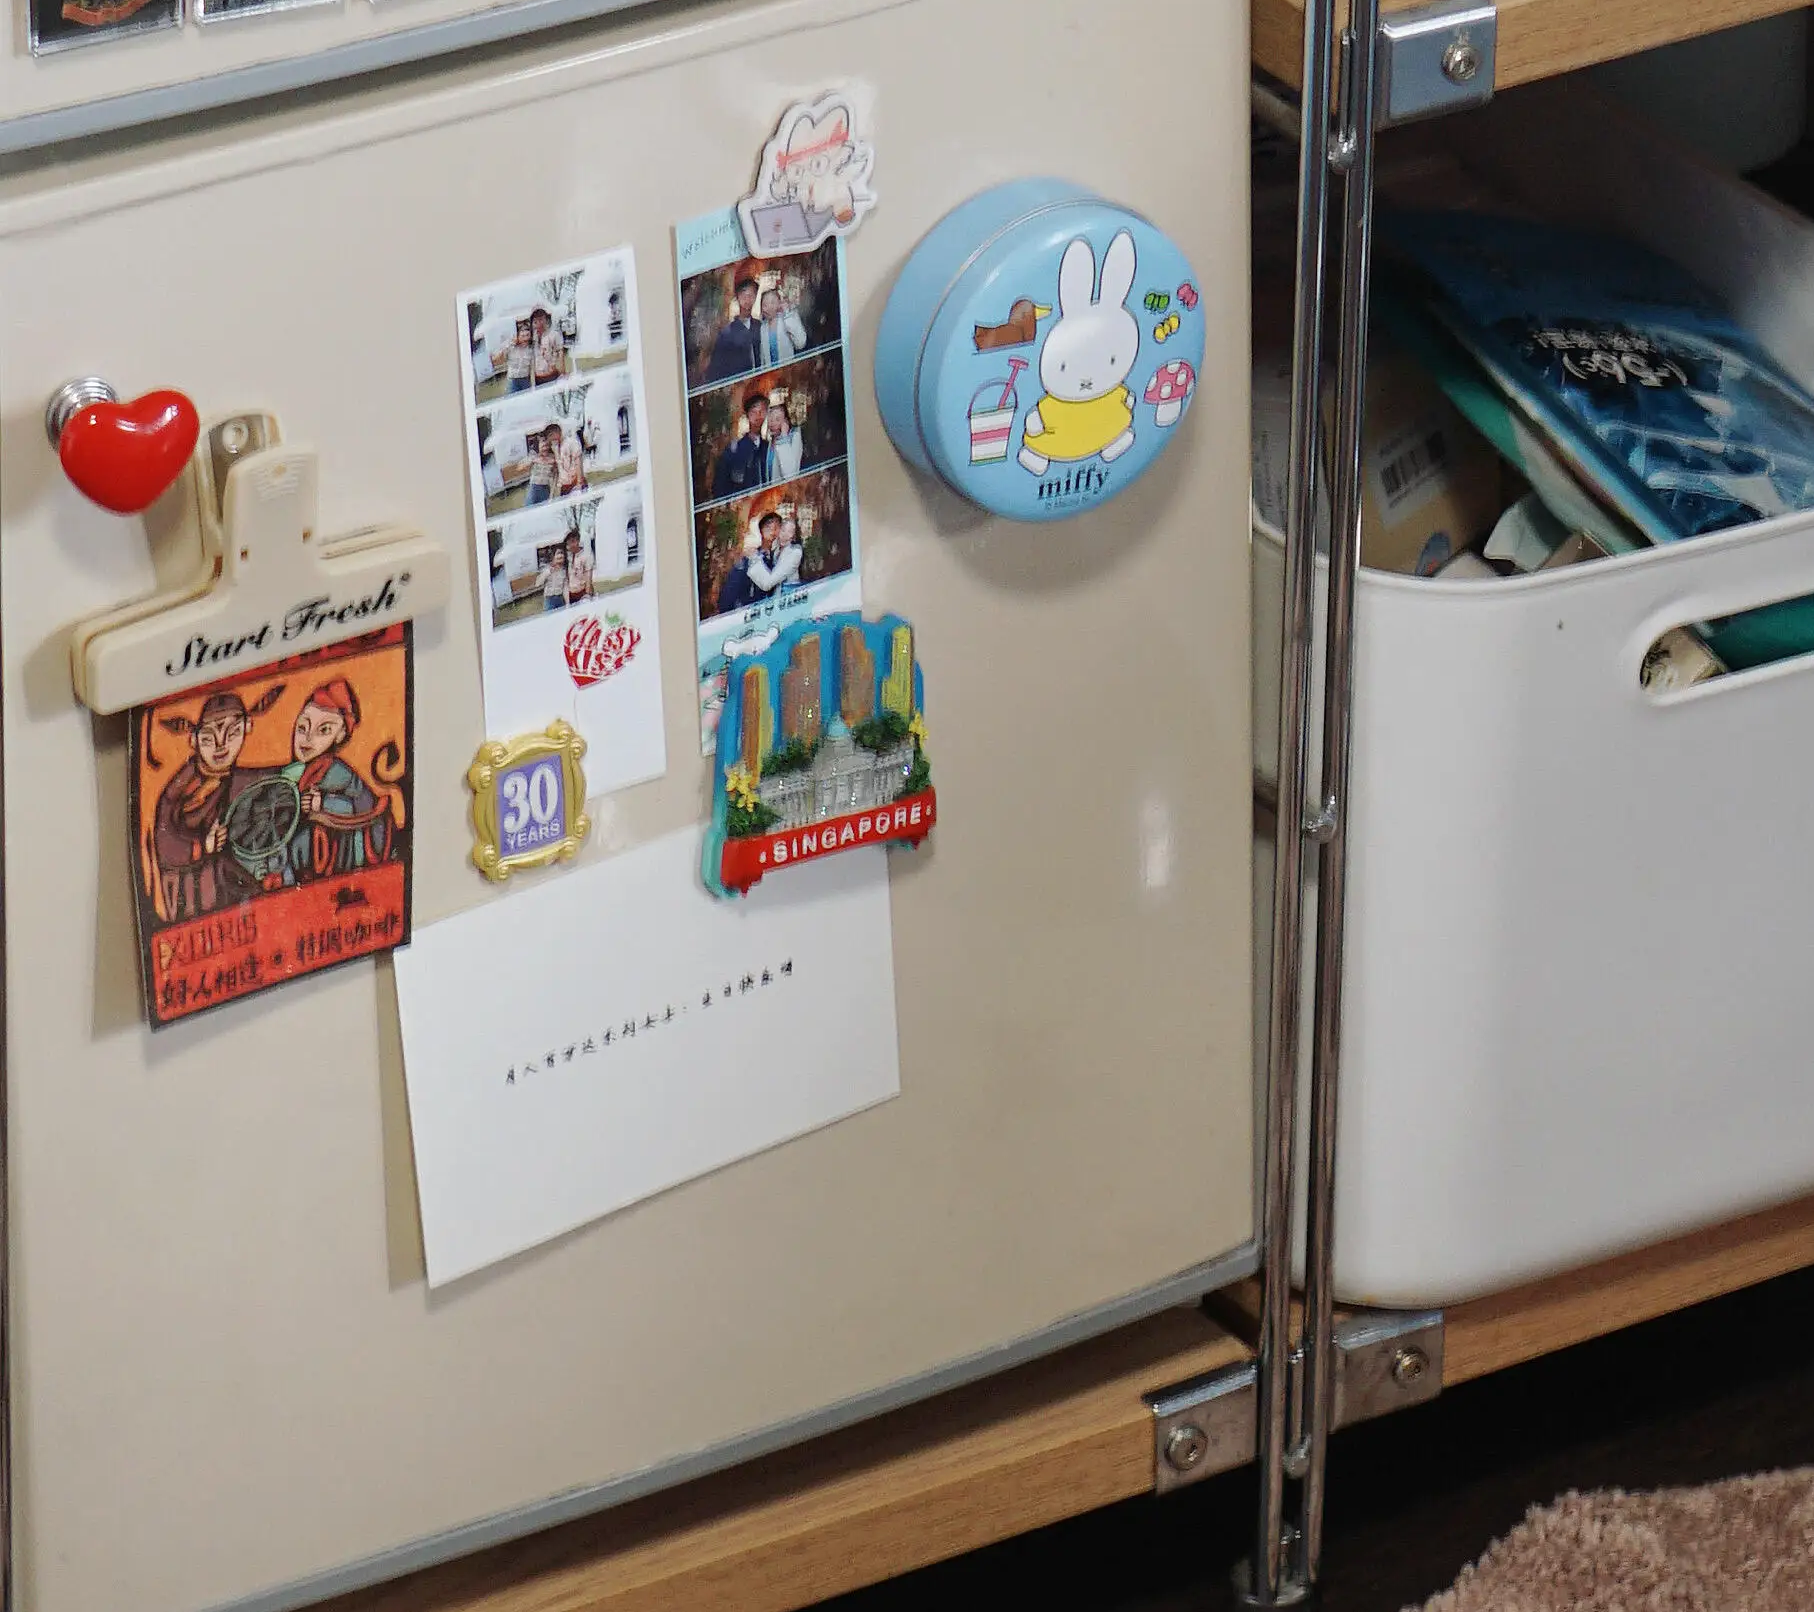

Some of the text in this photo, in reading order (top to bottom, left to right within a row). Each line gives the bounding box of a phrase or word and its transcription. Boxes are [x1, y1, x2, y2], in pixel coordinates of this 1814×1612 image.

[1037, 462, 1111, 500] miffy
[164, 634, 274, 677] Start
[503, 763, 559, 834] 30
[506, 818, 561, 851] YEARS
[772, 791, 922, 864] SINGAPORE
